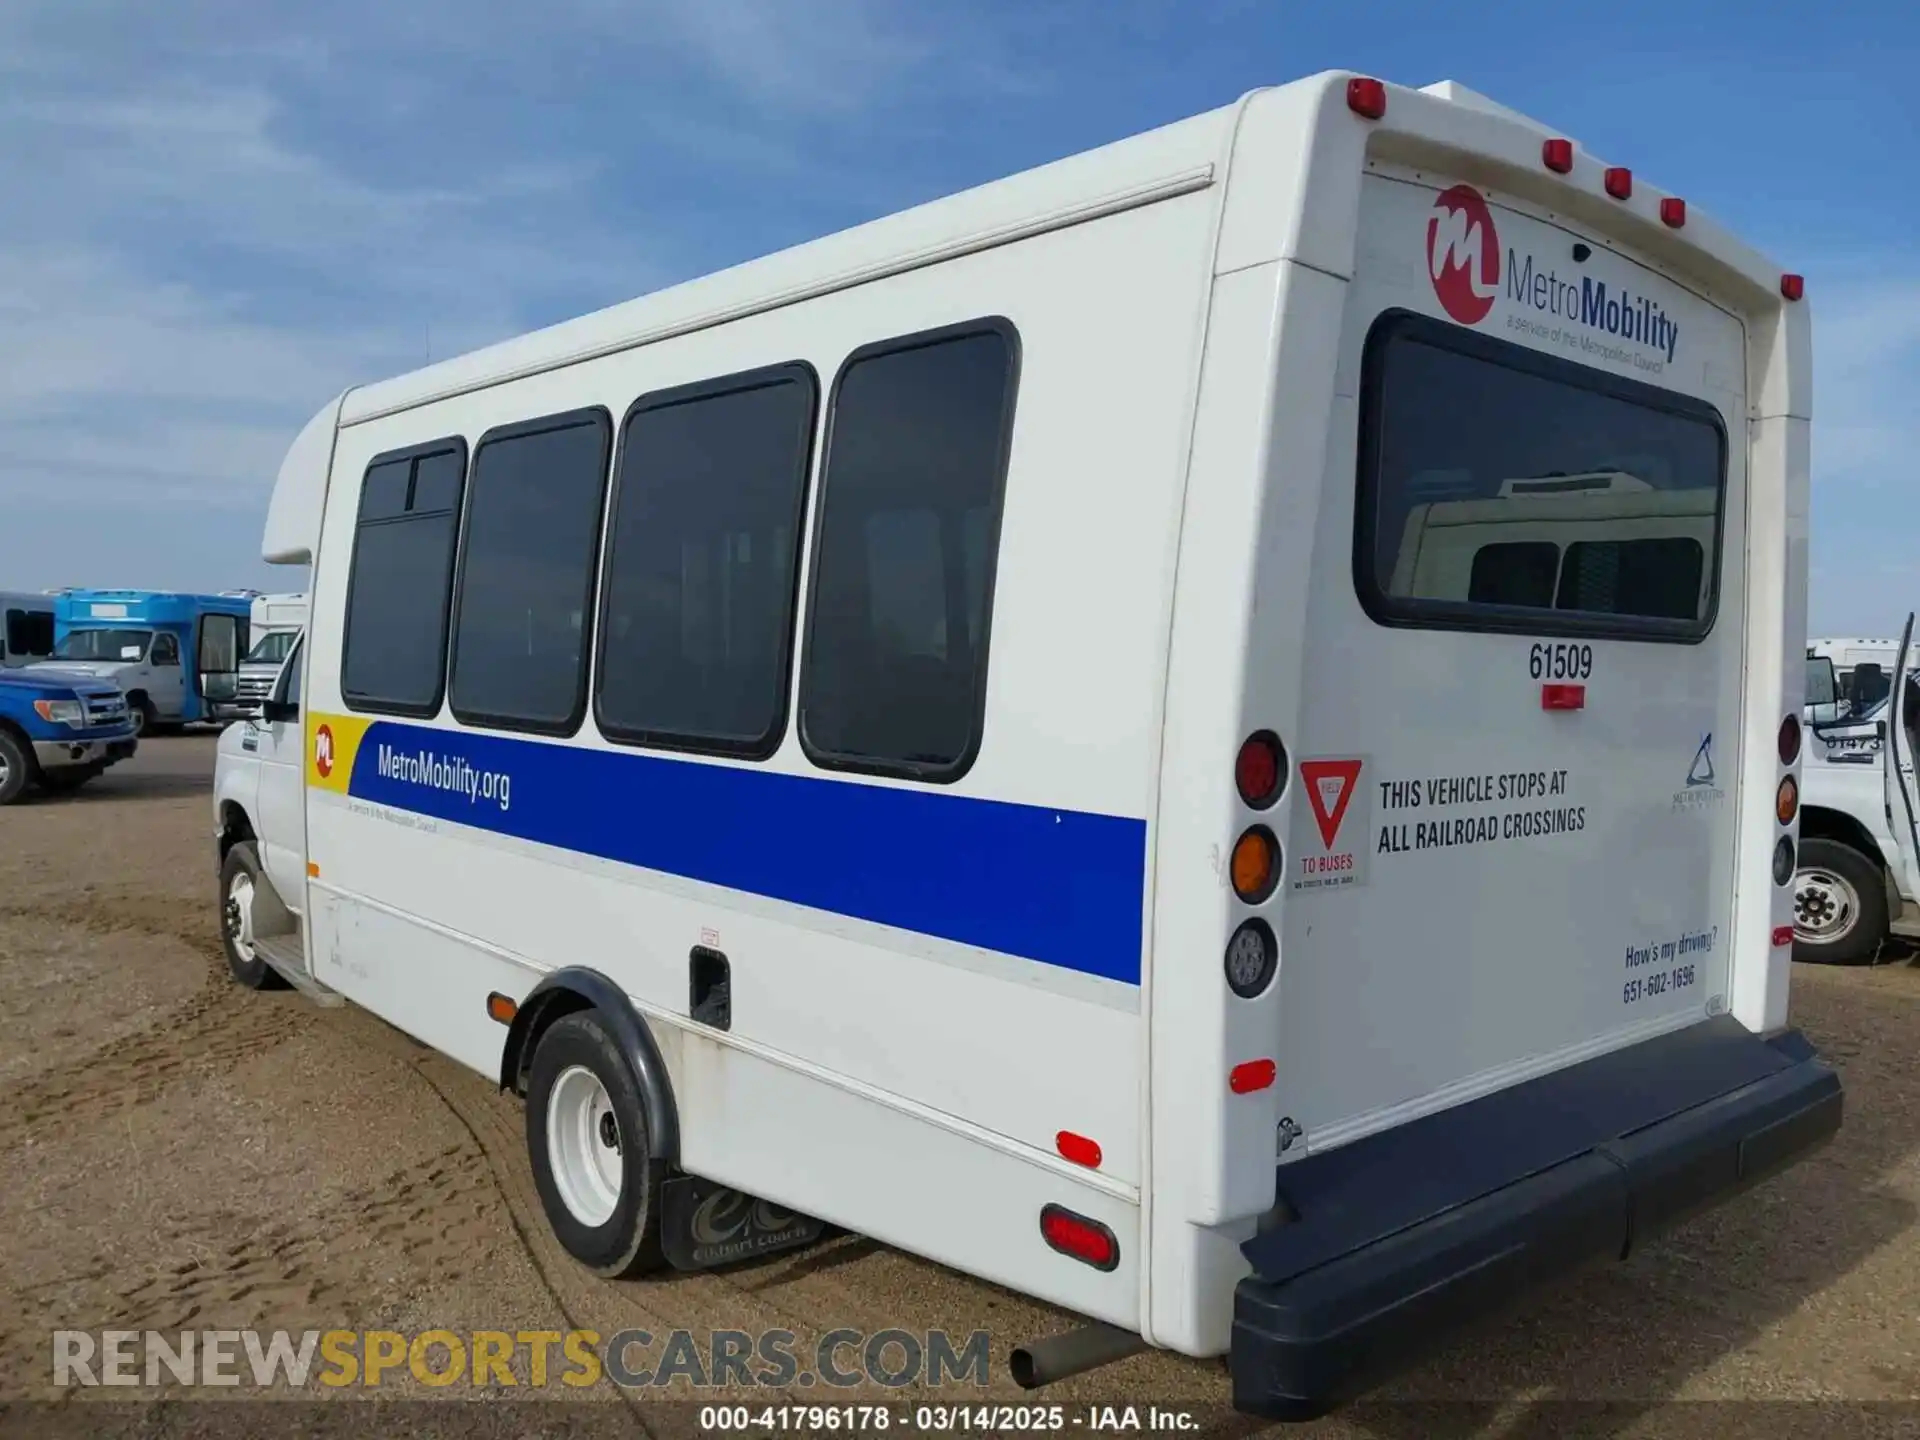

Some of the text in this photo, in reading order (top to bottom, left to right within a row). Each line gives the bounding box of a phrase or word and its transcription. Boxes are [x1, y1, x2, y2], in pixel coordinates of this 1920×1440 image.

[1507, 248, 1678, 363] MetroMobility
[1529, 643, 1593, 680] 61509
[377, 743, 510, 810] MetroMobility.org
[1379, 770, 1568, 809] THIS VEHICLE STOPS AT
[1377, 806, 1586, 854] ALL RAILROAD CROSSINGS
[1301, 853, 1353, 874] TO BUSES
[1625, 925, 1718, 969] How's my driving?
[1623, 964, 1695, 1005] 651-602-1696
